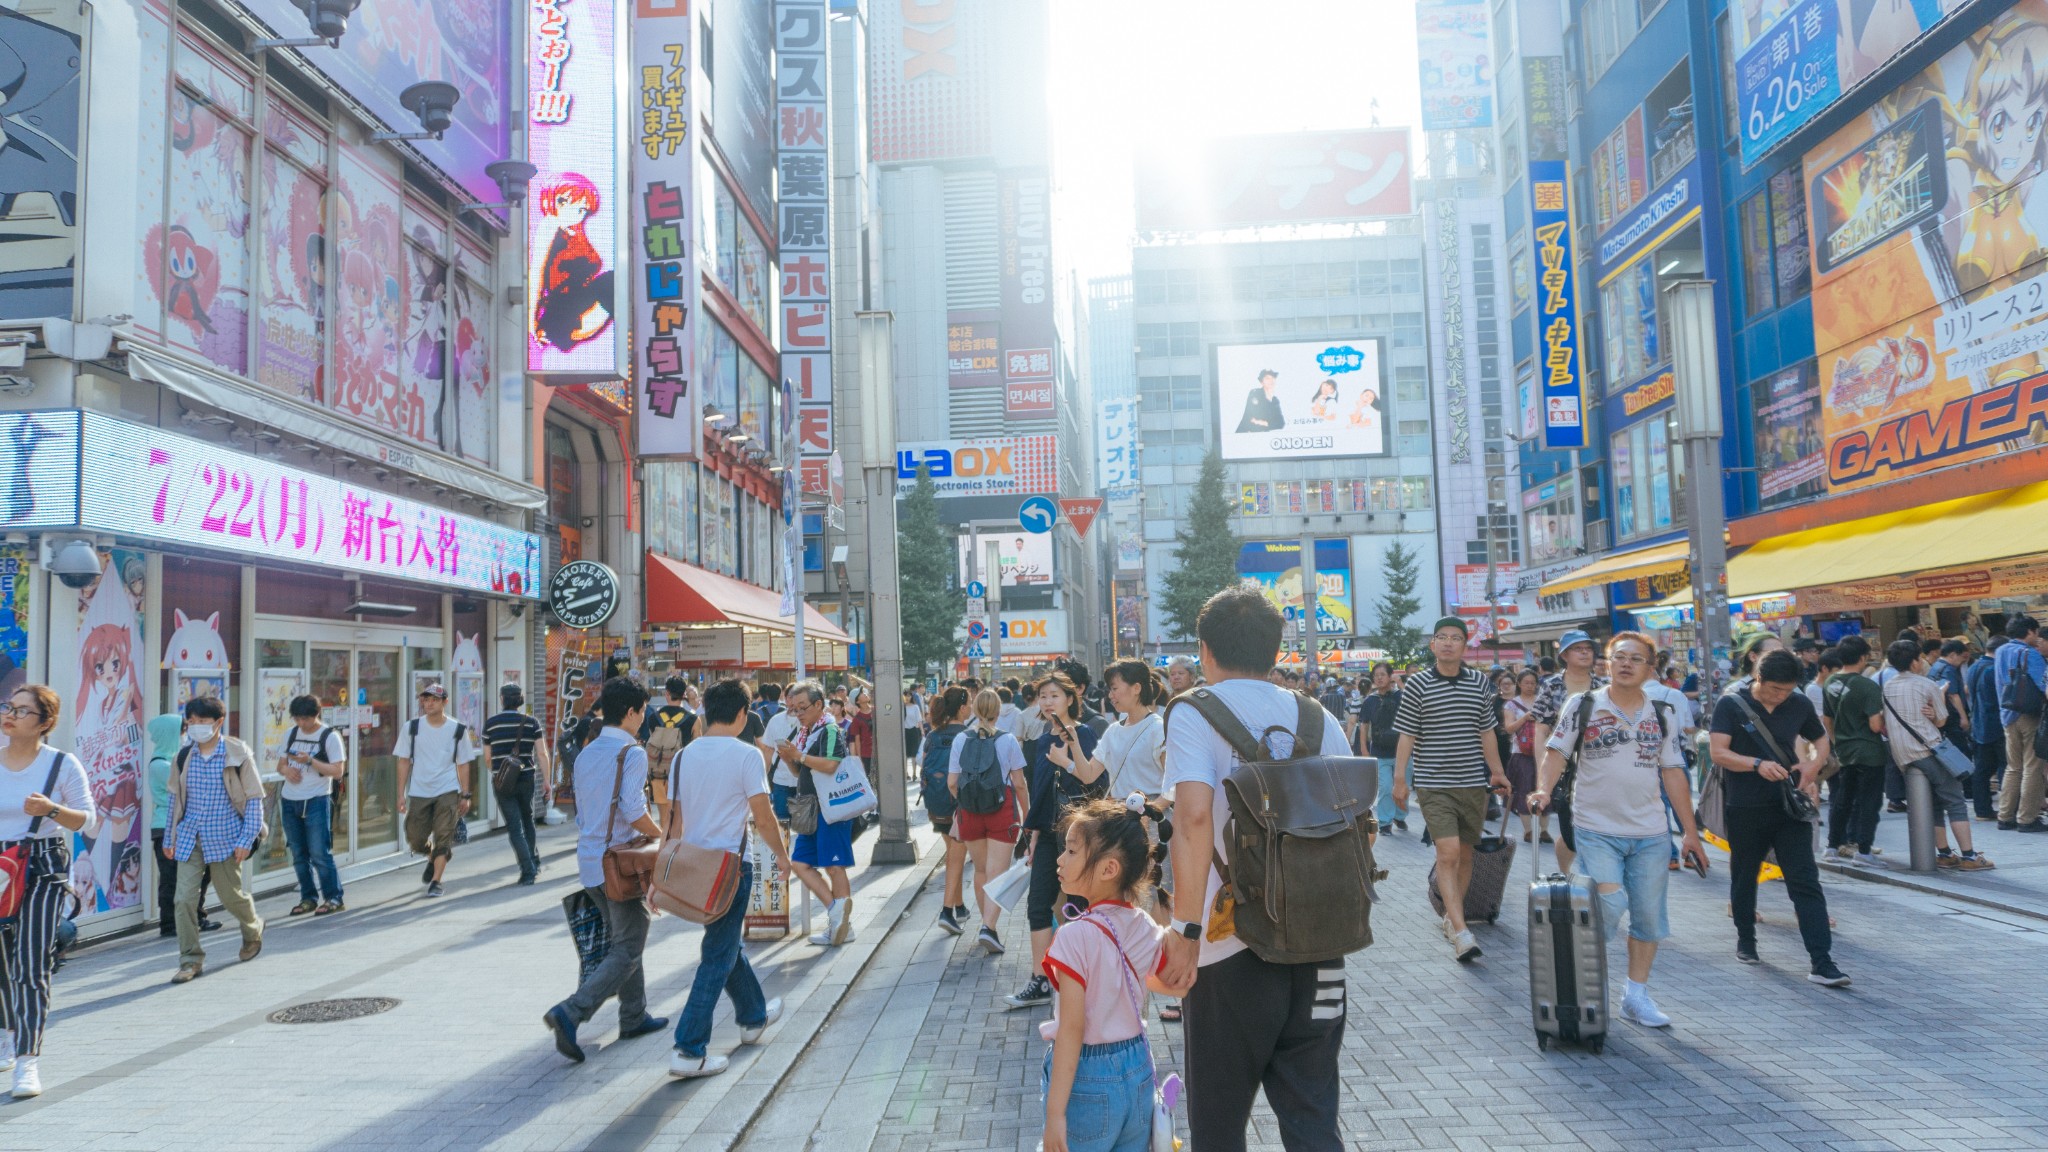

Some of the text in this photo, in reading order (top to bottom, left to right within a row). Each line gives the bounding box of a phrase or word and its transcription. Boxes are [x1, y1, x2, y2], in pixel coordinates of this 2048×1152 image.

[1803, 60, 1820, 81] On
[1804, 75, 1828, 101] Sale
[1748, 61, 1803, 141] 6.26
[641, 65, 664, 160] 買います
[1536, 183, 1563, 209] 薬
[1020, 244, 1049, 304] Free
[1010, 353, 1049, 373] 免税
[1009, 388, 1052, 404] 면세점
[1270, 436, 1333, 450] ONODEN
[388, 450, 414, 468] ESPACE
[986, 479, 1015, 489] Store
[1068, 505, 1095, 515] 止まれ
[556, 564, 609, 587] SMOKER'S
[571, 575, 594, 590] Cafe
[556, 602, 608, 625] VAPE STAND
[1347, 650, 1381, 660] Canon
